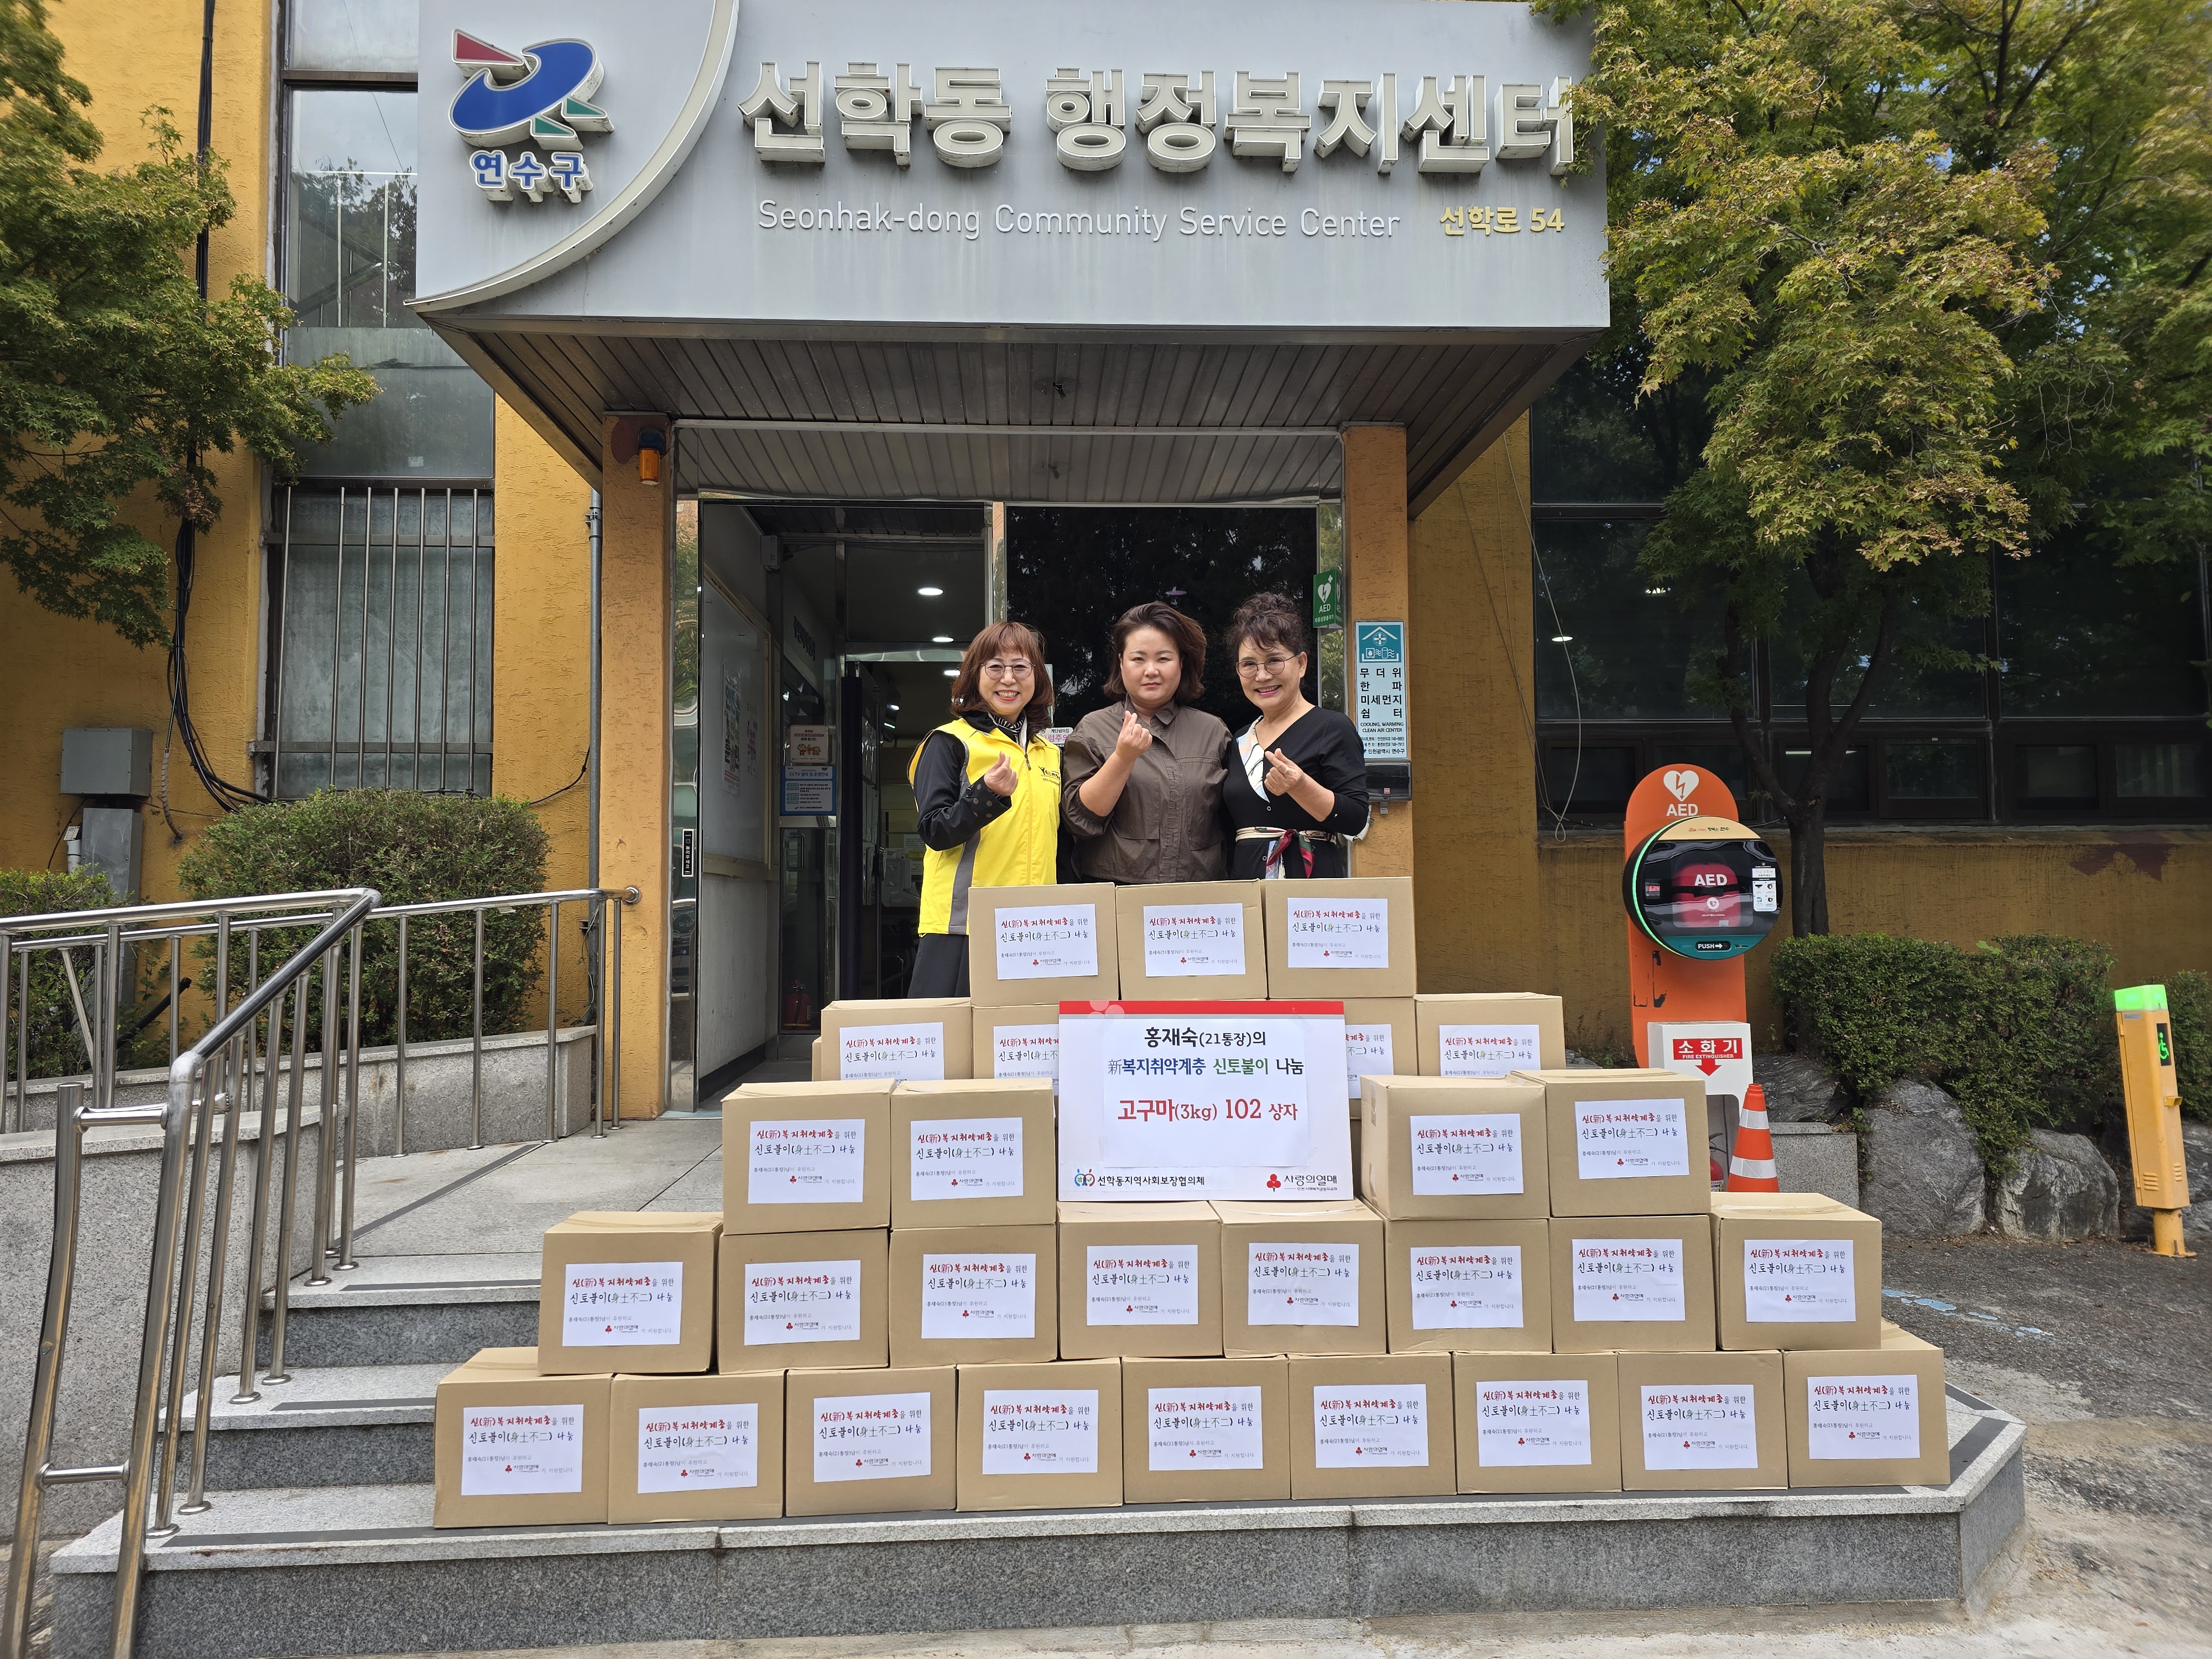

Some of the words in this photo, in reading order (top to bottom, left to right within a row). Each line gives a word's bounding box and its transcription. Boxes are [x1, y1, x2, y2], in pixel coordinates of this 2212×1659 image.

[737, 61, 1011, 166] 선학동
[1046, 68, 1573, 174] 행정복지센터
[472, 151, 585, 189] 연수구
[759, 200, 980, 240] Seonhak-dong
[995, 204, 1167, 241] Community
[1180, 207, 1286, 236] Service
[1301, 208, 1400, 237] Center
[1438, 206, 1521, 236] 선학로
[1530, 207, 1564, 233] 54
[1319, 604, 1331, 613] AED
[1361, 695, 1402, 705] 미세먼지
[1666, 804, 1698, 816] AED
[1694, 874, 1727, 886] AED
[1366, 924, 1380, 932] 나눔
[1074, 930, 1088, 938] 나눔
[1144, 1027, 1266, 1048] 홍재숙(21통장)의
[1679, 1040, 1737, 1053] 소화기
[922, 1049, 936, 1058] 나눔
[1108, 1058, 1206, 1076] 新복지취약계층
[1213, 1058, 1269, 1075] 신토불이
[1276, 1058, 1304, 1075] 나눔
[1118, 1099, 1217, 1121] 고구마(3kg)
[1225, 1098, 1261, 1119] 102
[1268, 1103, 1298, 1121] 상자
[1665, 1114, 1677, 1122] 위한
[1501, 1129, 1513, 1138] 위한
[1662, 1127, 1677, 1136] 나눔
[1003, 1133, 1014, 1141] 위한
[840, 1144, 855, 1154] 나눔
[999, 1146, 1014, 1156] 나눔
[1498, 1142, 1513, 1152] 나눔
[1098, 1176, 1205, 1186] 선학동지역사회보장협의체
[1284, 1175, 1337, 1186] 사랑의열매
[1015, 1265, 1027, 1273] 위한
[1178, 1260, 1190, 1269] 위한
[1830, 1264, 1845, 1274] 나눔
[1174, 1274, 1189, 1284] 나눔
[1498, 1270, 1512, 1279] 나눔
[661, 1278, 674, 1286] 위한
[839, 1276, 852, 1285] 위한
[1011, 1279, 1026, 1288] 나눔
[657, 1292, 673, 1302] 나눔
[836, 1290, 851, 1300] 나눔
[1898, 1387, 1910, 1395] 위한
[1406, 1400, 1418, 1409] 위한
[1733, 1395, 1745, 1404] 위한
[1895, 1400, 1910, 1410] 나눔
[909, 1410, 922, 1418] 위한
[1077, 1406, 1090, 1415] 위한
[1730, 1409, 1746, 1419] 나눔
[561, 1417, 575, 1425] 위한
[736, 1420, 749, 1429] 위한
[1403, 1415, 1418, 1425] 나눔
[906, 1424, 921, 1434] 나눔
[1073, 1420, 1089, 1431] 나눔
[557, 1431, 573, 1441] 나눔
[732, 1434, 748, 1444] 나눔
